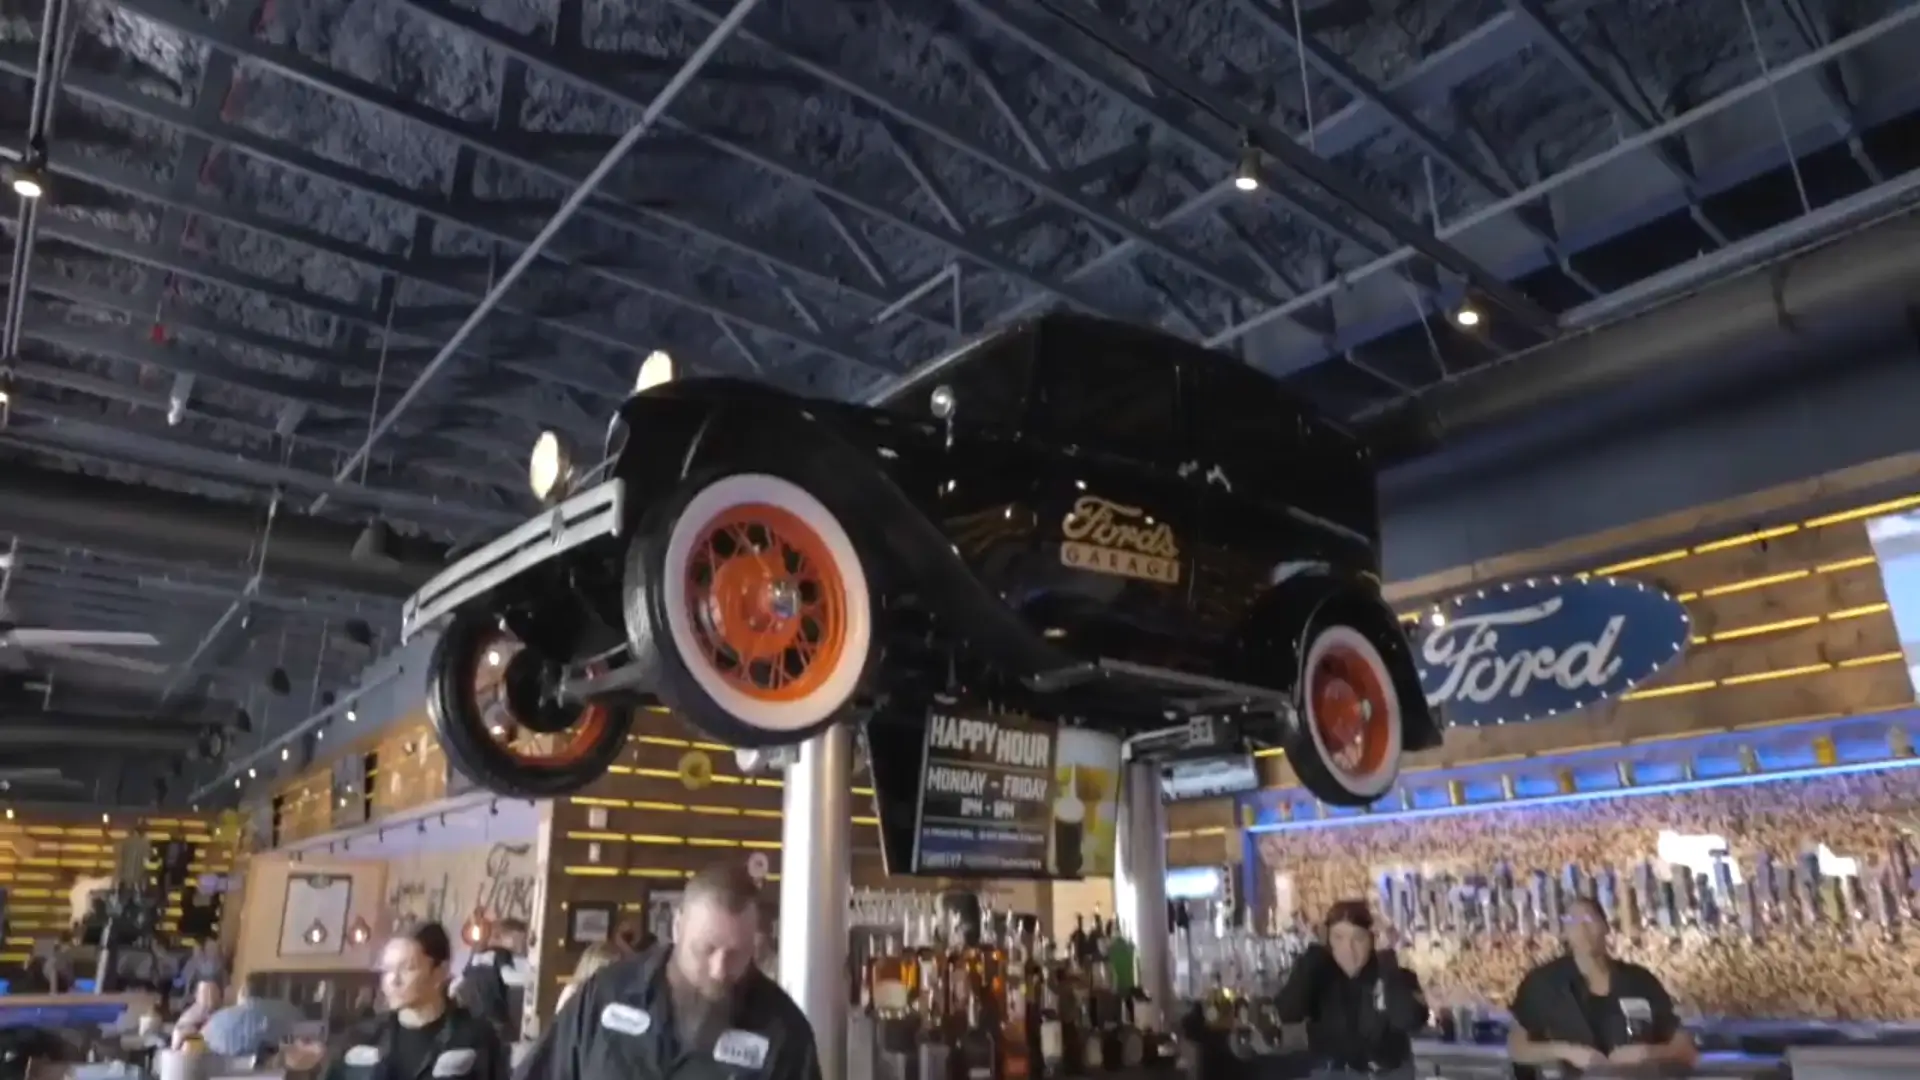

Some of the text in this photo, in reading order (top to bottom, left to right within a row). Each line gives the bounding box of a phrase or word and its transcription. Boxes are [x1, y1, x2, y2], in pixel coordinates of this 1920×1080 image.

[1422, 597, 1626, 705] Ford
[930, 715, 1049, 769] HAPPY HOUR
[927, 766, 986, 795] MONDAY
[1003, 775, 1047, 801] FRIDAY
[484, 842, 534, 918] For
